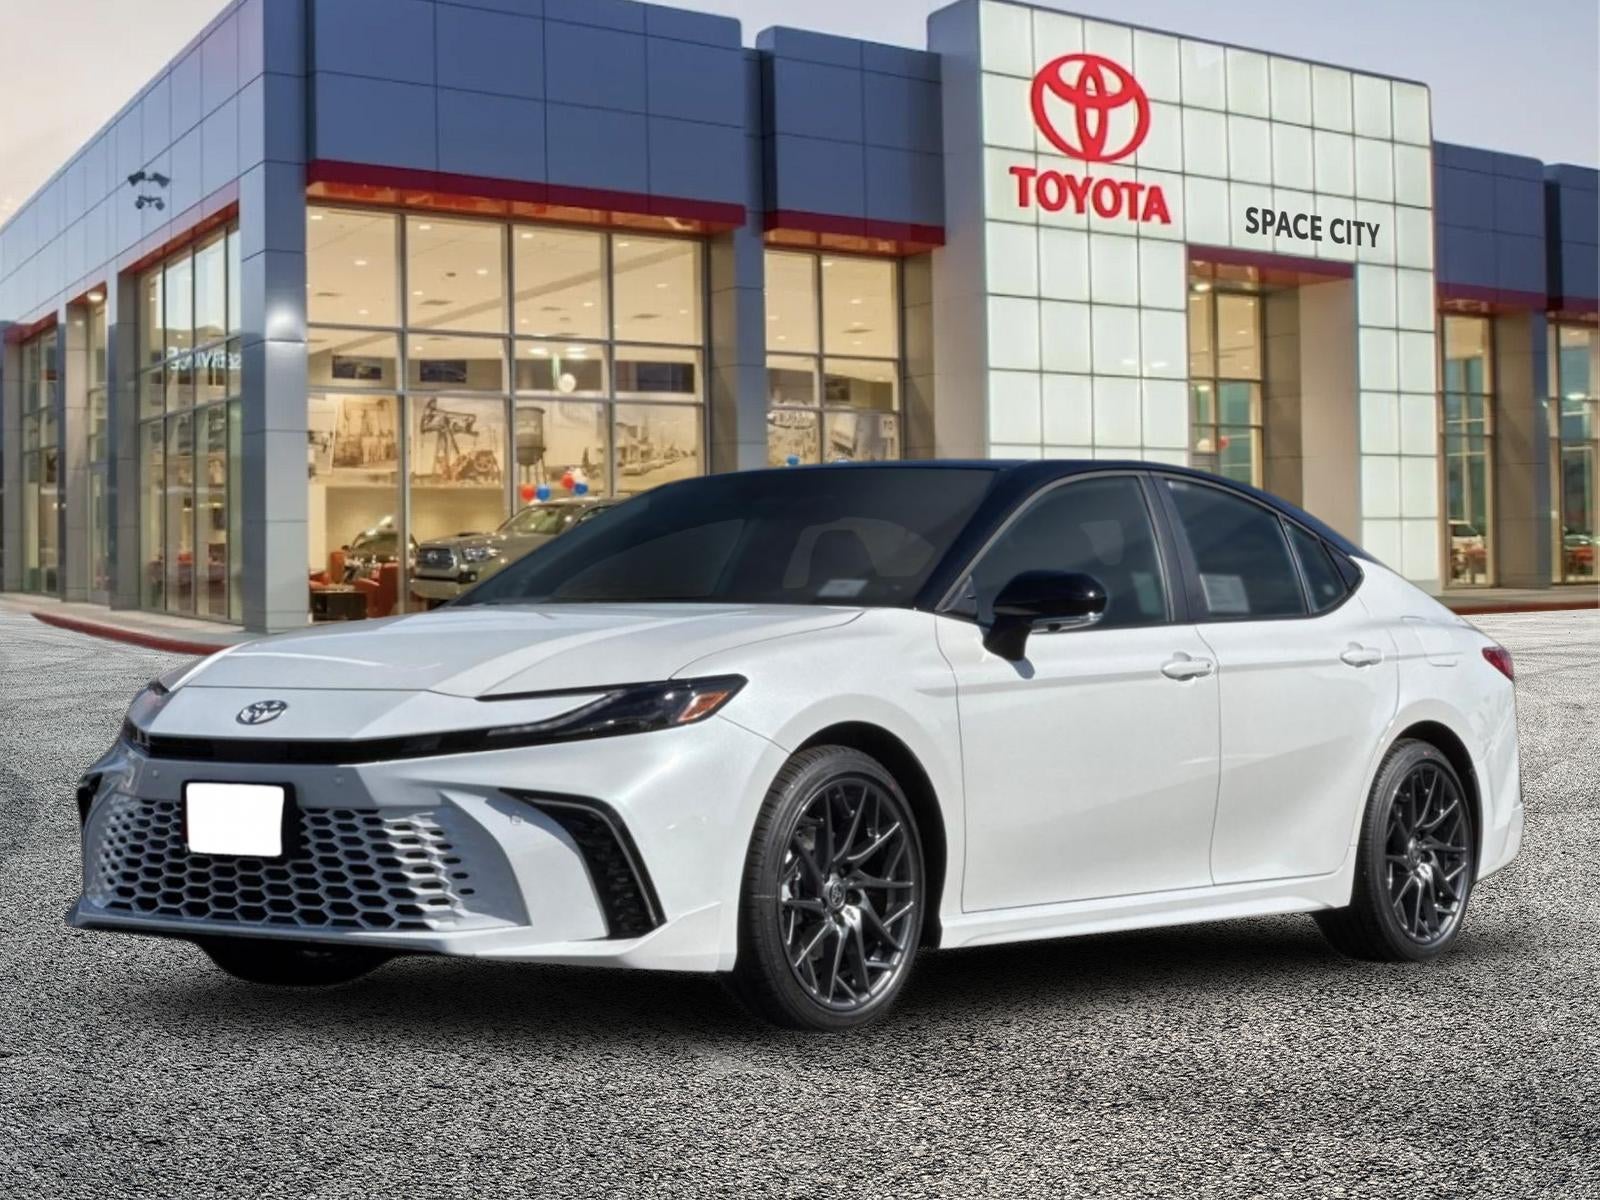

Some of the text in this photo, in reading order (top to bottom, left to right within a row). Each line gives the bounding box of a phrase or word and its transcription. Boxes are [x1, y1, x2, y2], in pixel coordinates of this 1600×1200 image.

[1009, 165, 1172, 225] TOYOTA
[1245, 206, 1381, 248] SPACE CITY
